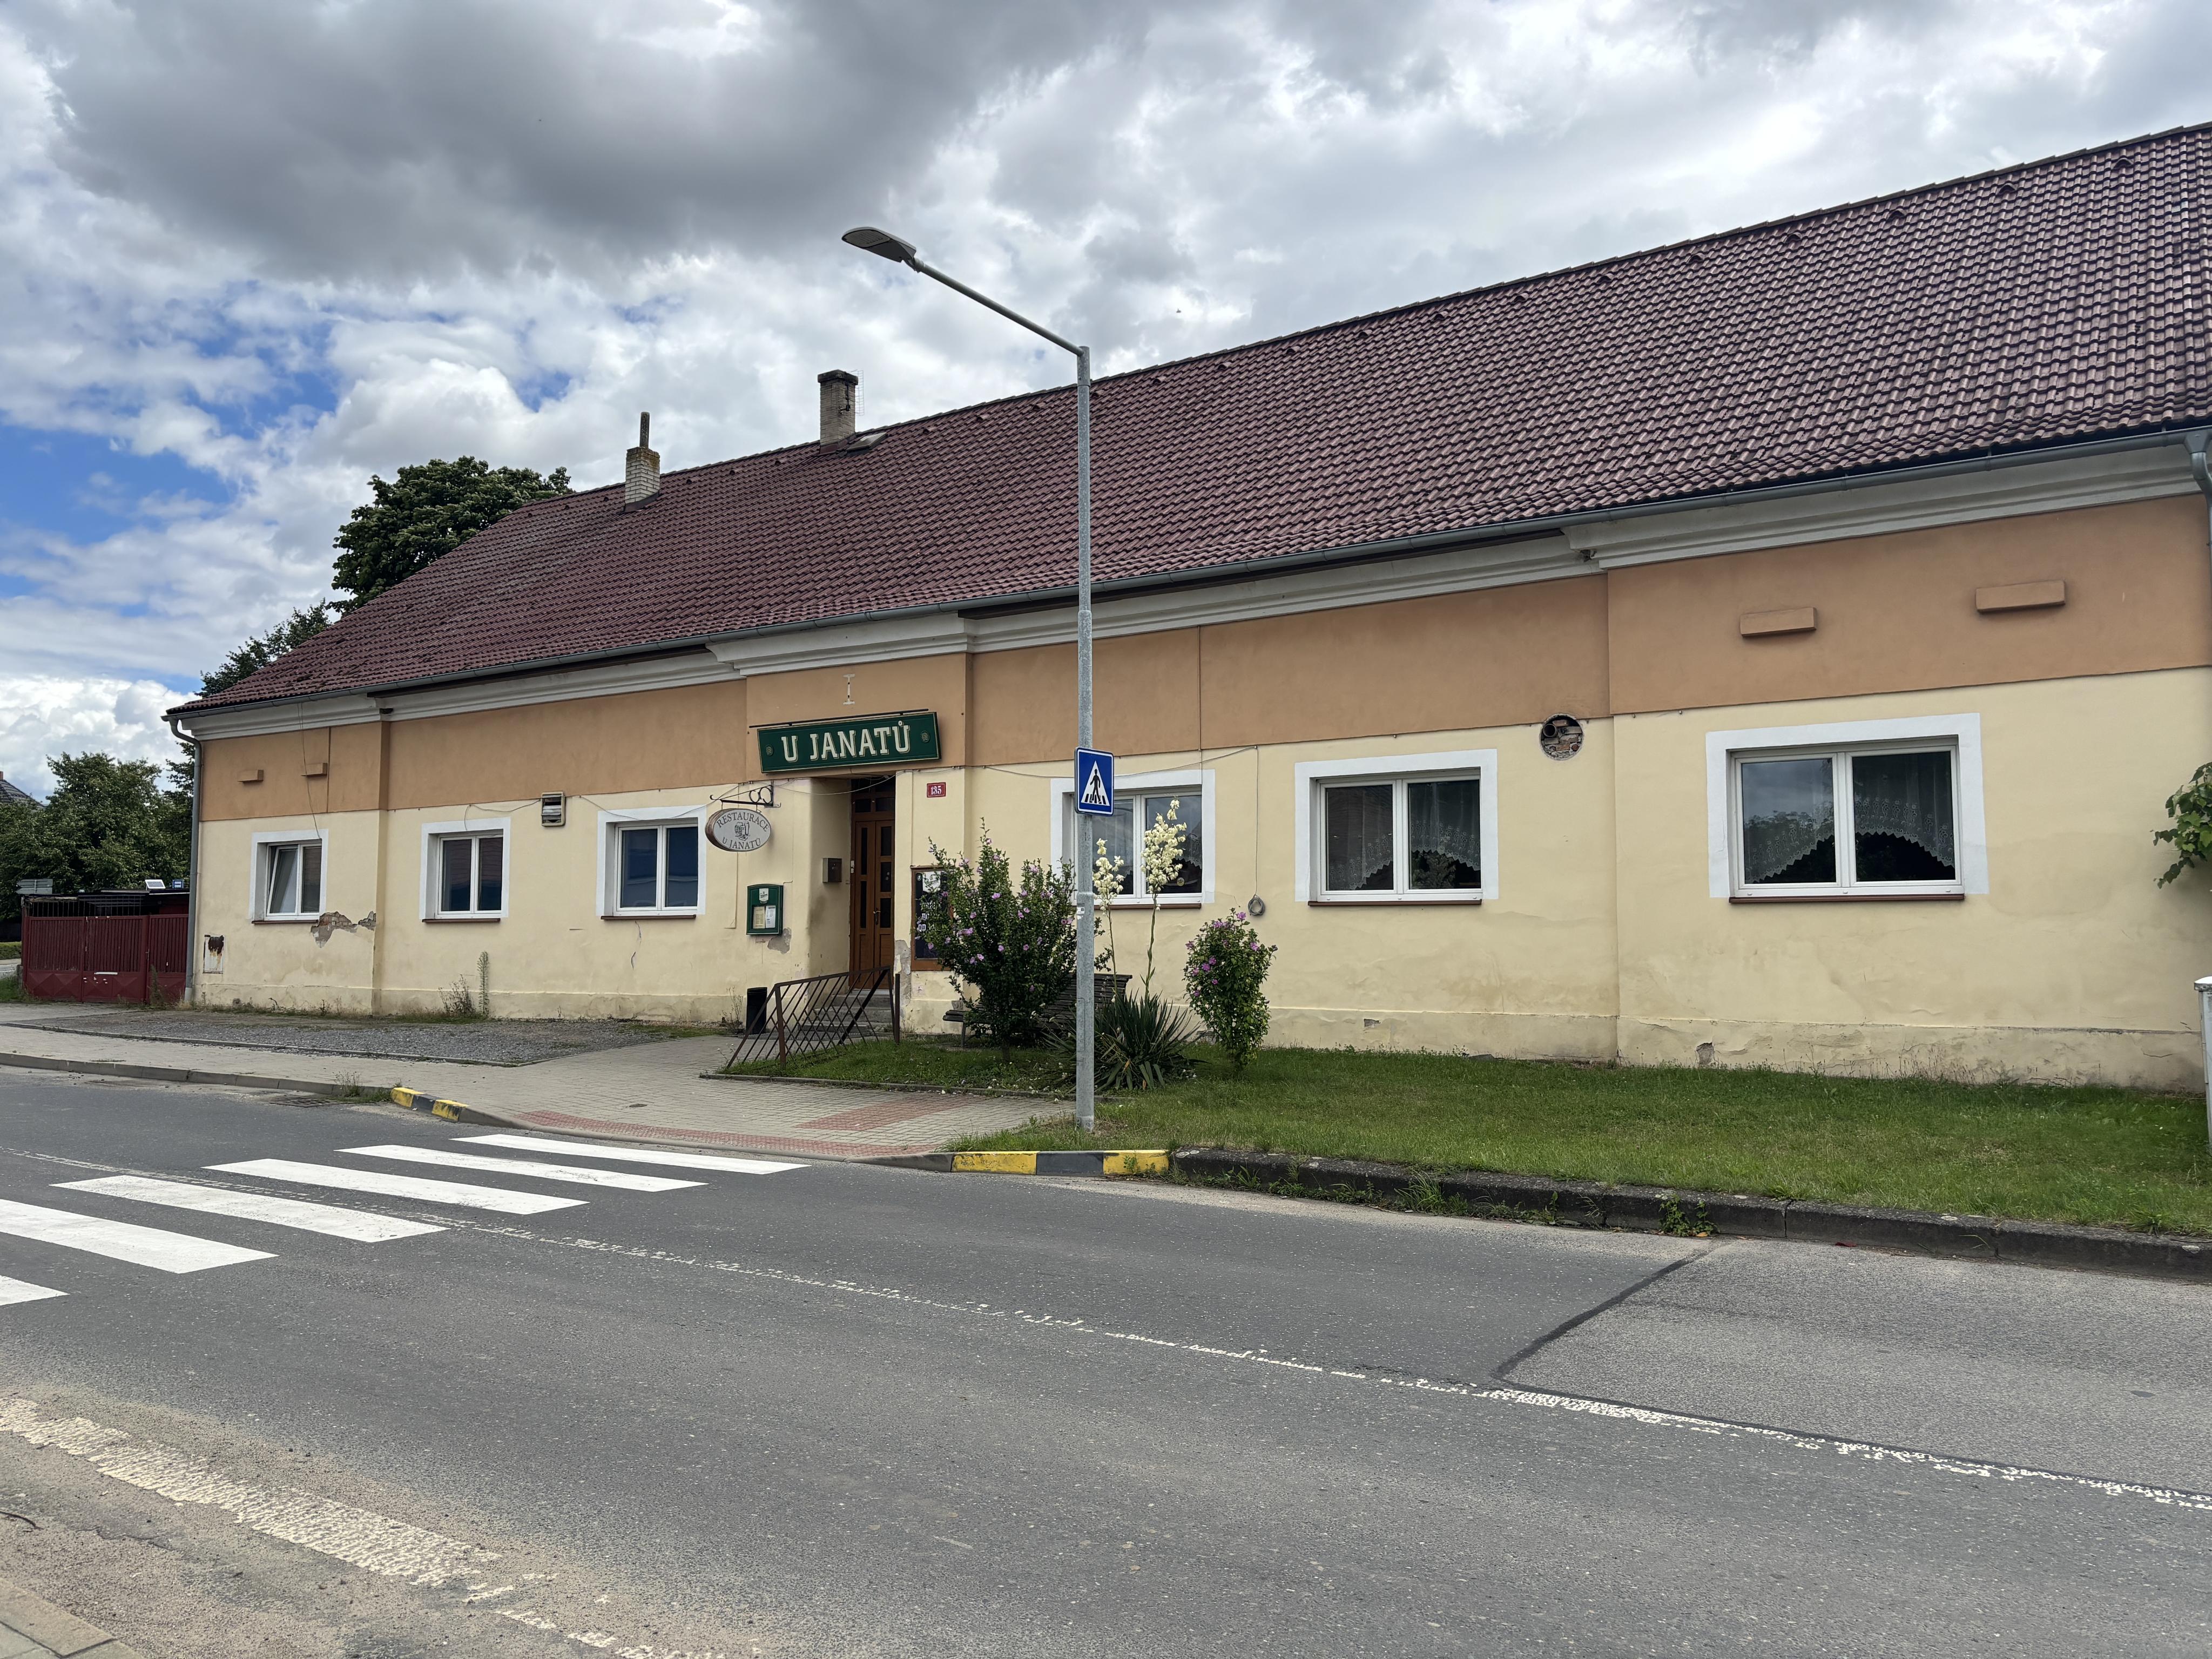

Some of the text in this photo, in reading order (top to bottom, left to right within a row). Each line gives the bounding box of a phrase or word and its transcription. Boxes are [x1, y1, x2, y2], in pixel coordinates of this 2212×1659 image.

[781, 720, 911, 762] U JANATŮ
[930, 785, 942, 795] 135
[717, 812, 770, 832] RESTAURACE
